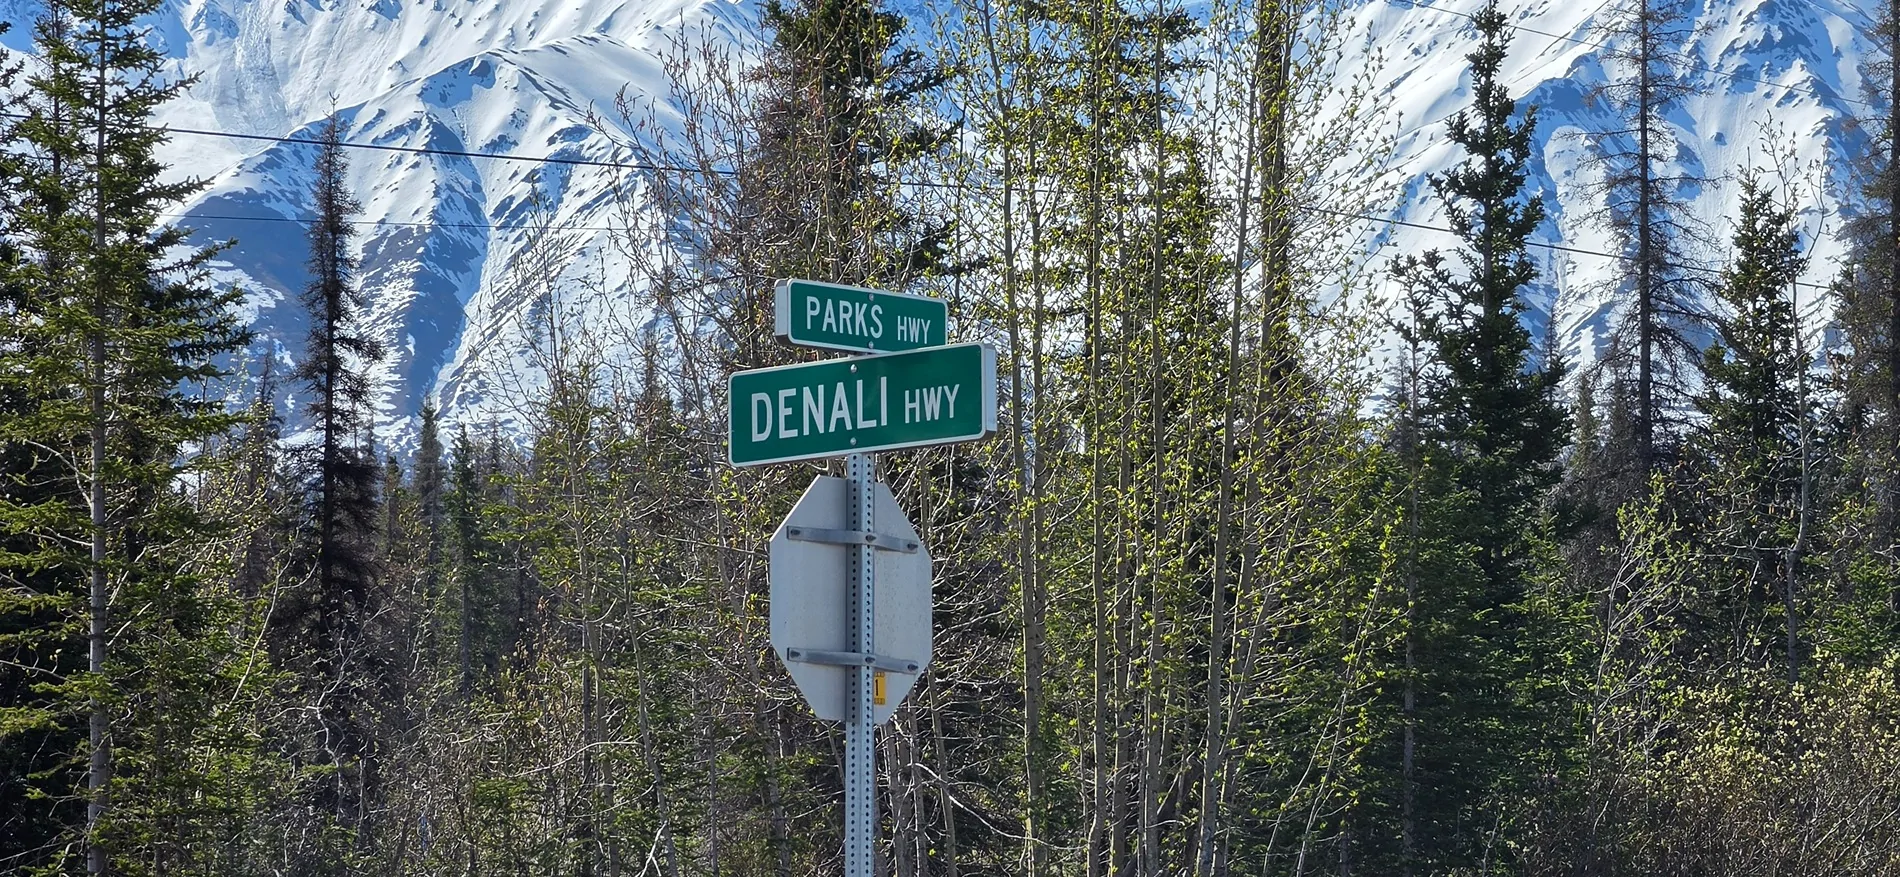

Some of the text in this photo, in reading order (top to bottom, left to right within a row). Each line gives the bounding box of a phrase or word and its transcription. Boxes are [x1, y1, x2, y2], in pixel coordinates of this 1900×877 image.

[806, 295, 931, 344] PARKS HWY
[751, 376, 960, 442] DENALI HWY
